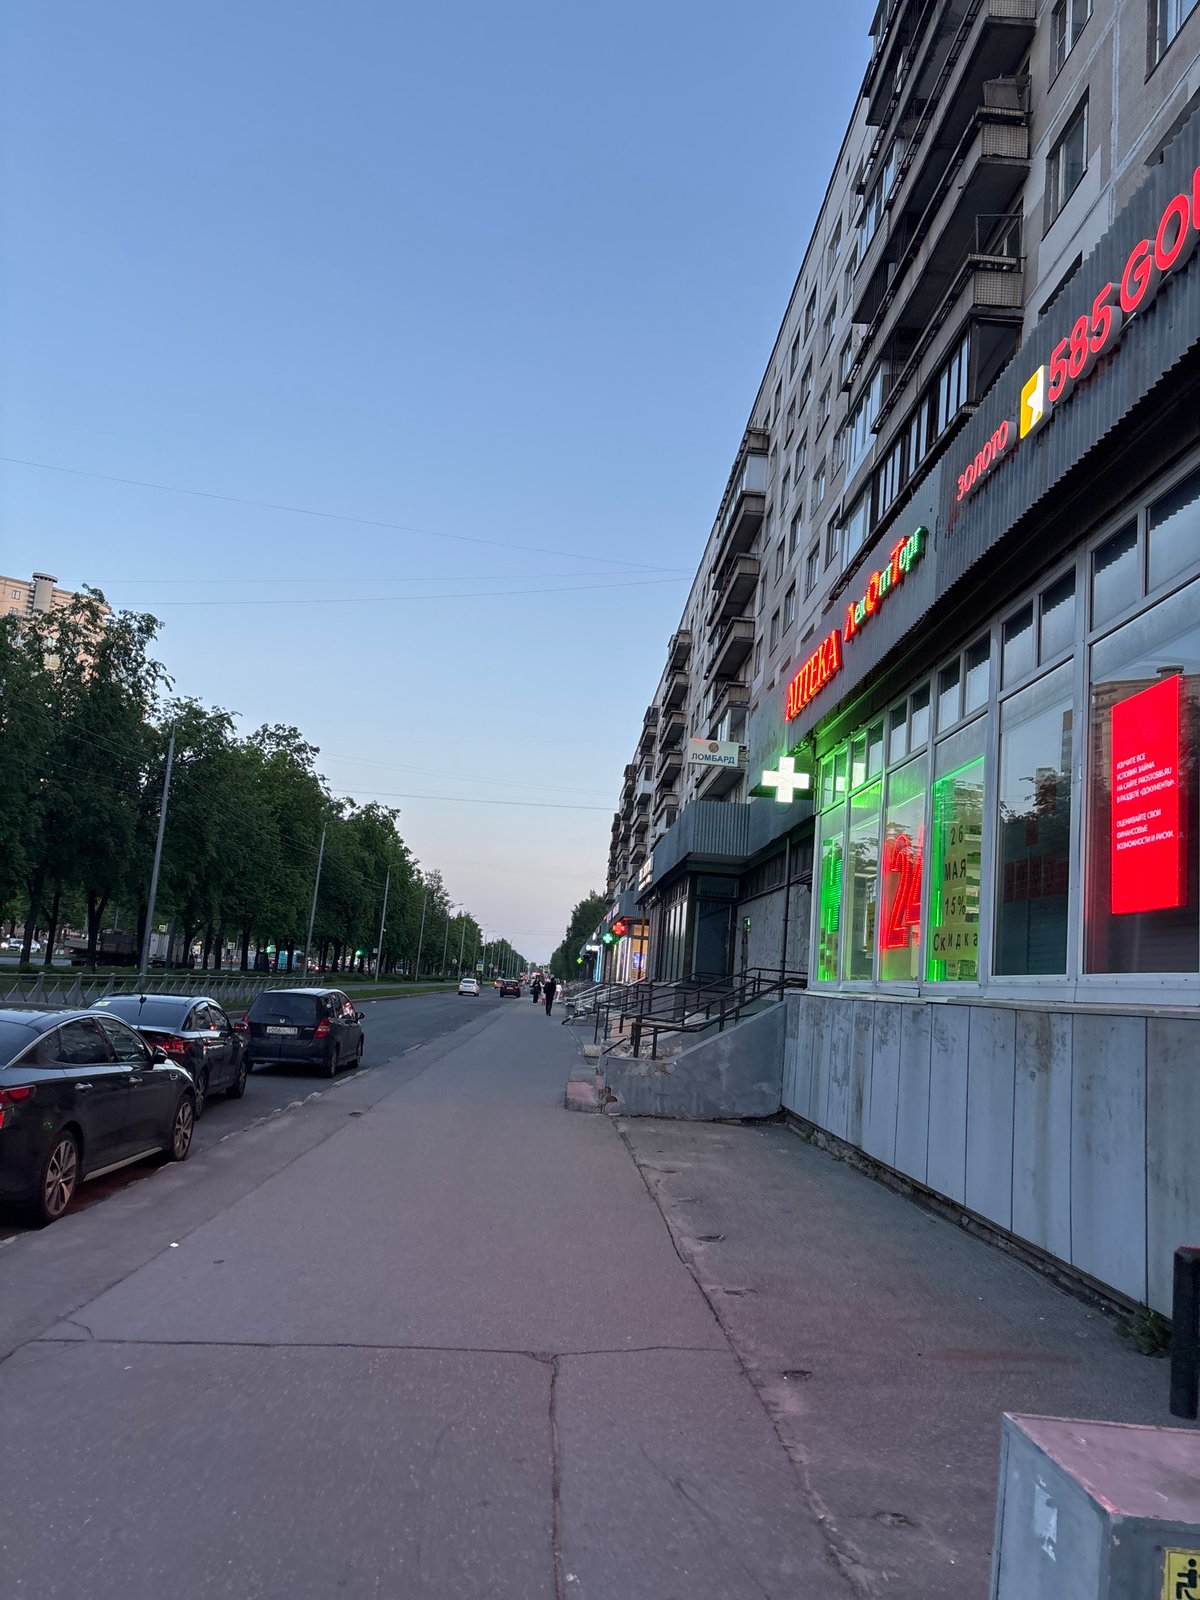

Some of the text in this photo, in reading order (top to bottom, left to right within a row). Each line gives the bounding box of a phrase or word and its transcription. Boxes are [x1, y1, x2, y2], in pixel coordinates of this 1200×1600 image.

[957, 420, 1008, 500] ЗОЛОТО
[1049, 283, 1111, 401] 585
[785, 629, 841, 722] АПТЕКА
[691, 752, 735, 765] ЛОМБАРД
[1137, 753, 1145, 762] ВСЕ
[1117, 761, 1154, 780] УСЛОВИЯ ЗАЙМА
[1123, 779, 1137, 789] САЙТЕ
[1120, 790, 1139, 801] РАЗДЕЛЕ
[1117, 809, 1161, 827] ОЦЕНИВАЙТЕ СВОИ
[951, 825, 964, 846] 26
[1117, 824, 1148, 838] ФИНАНСОВЫЕ
[1117, 836, 1151, 850] ВОЗМОЖНОСТИ
[945, 858, 967, 880] МАЯ
[945, 896, 966, 916] 15%
[933, 931, 978, 952] Скидка
